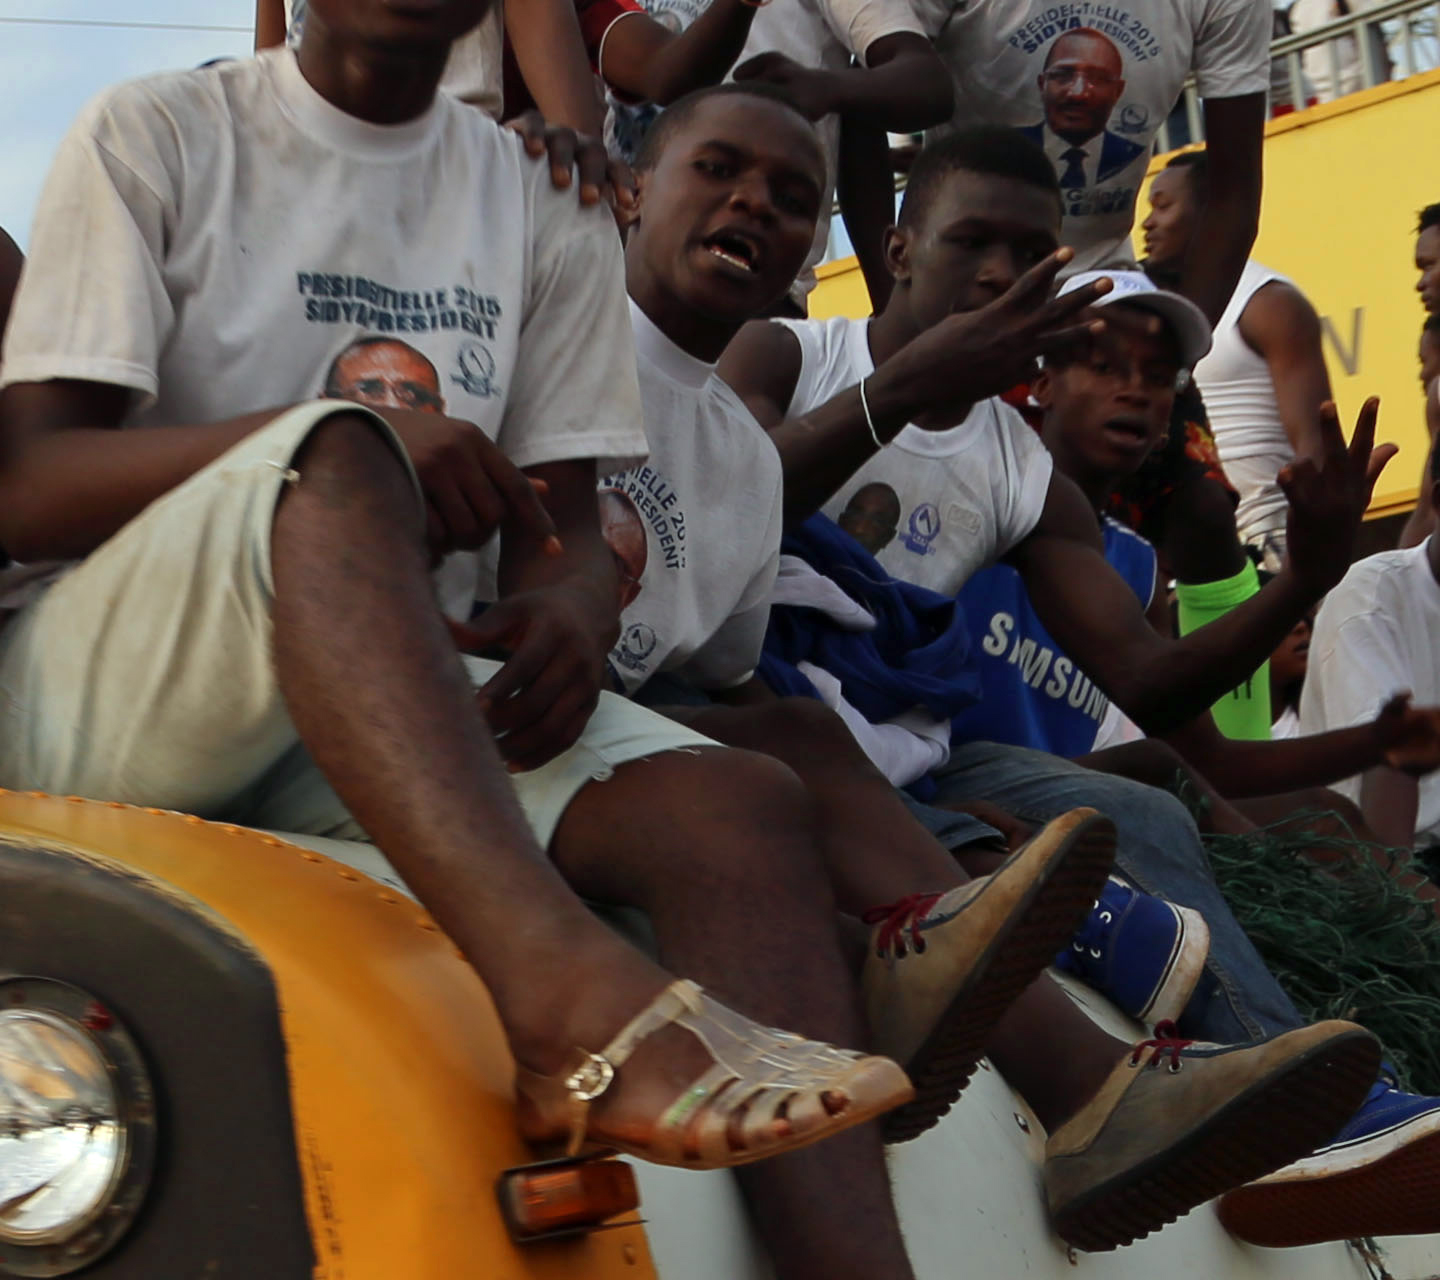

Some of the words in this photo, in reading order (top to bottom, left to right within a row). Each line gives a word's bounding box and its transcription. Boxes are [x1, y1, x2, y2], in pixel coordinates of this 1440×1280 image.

[1022, 16, 1081, 54] SIDYA
[1087, 18, 1150, 62] PRESIDENT
[627, 483, 681, 570] PRESIDENT
[982, 611, 1109, 726] SMSUN
